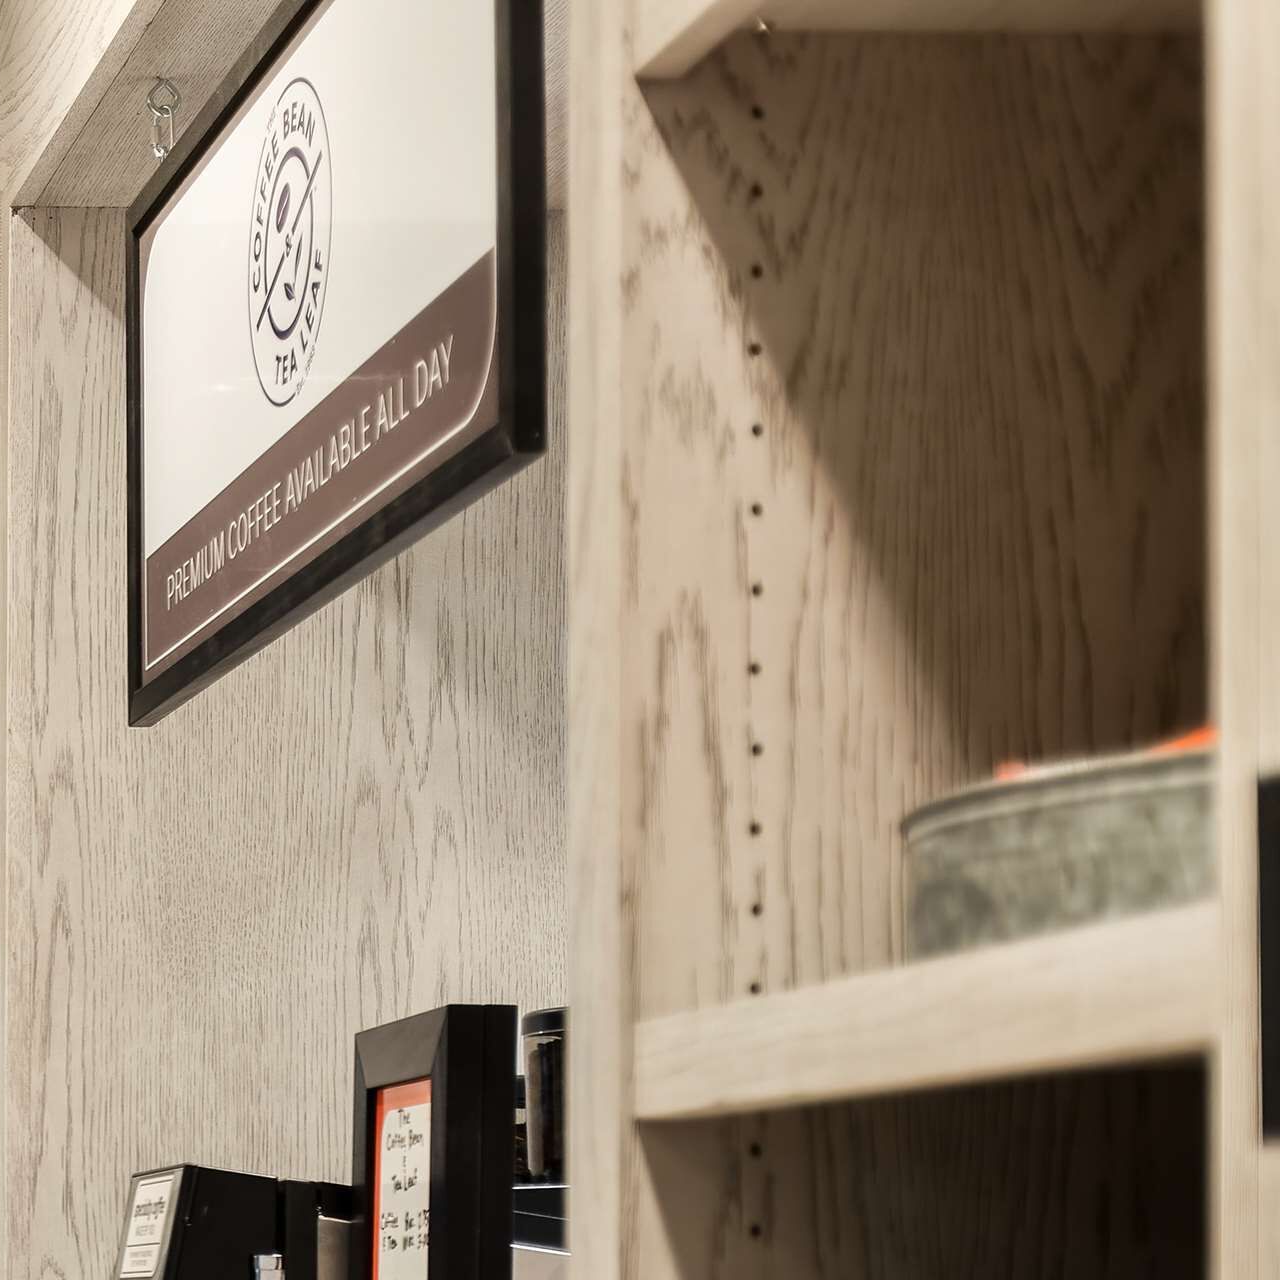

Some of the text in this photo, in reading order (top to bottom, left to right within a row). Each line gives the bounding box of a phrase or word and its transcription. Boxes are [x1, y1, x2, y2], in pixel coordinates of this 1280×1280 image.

[253, 101, 315, 293] COFFEE BEAN
[275, 354, 298, 385] TEA
[301, 248, 323, 354] LEAF
[166, 335, 455, 611] PREMIUM COFFEE AVAILABLE ALL DAY
